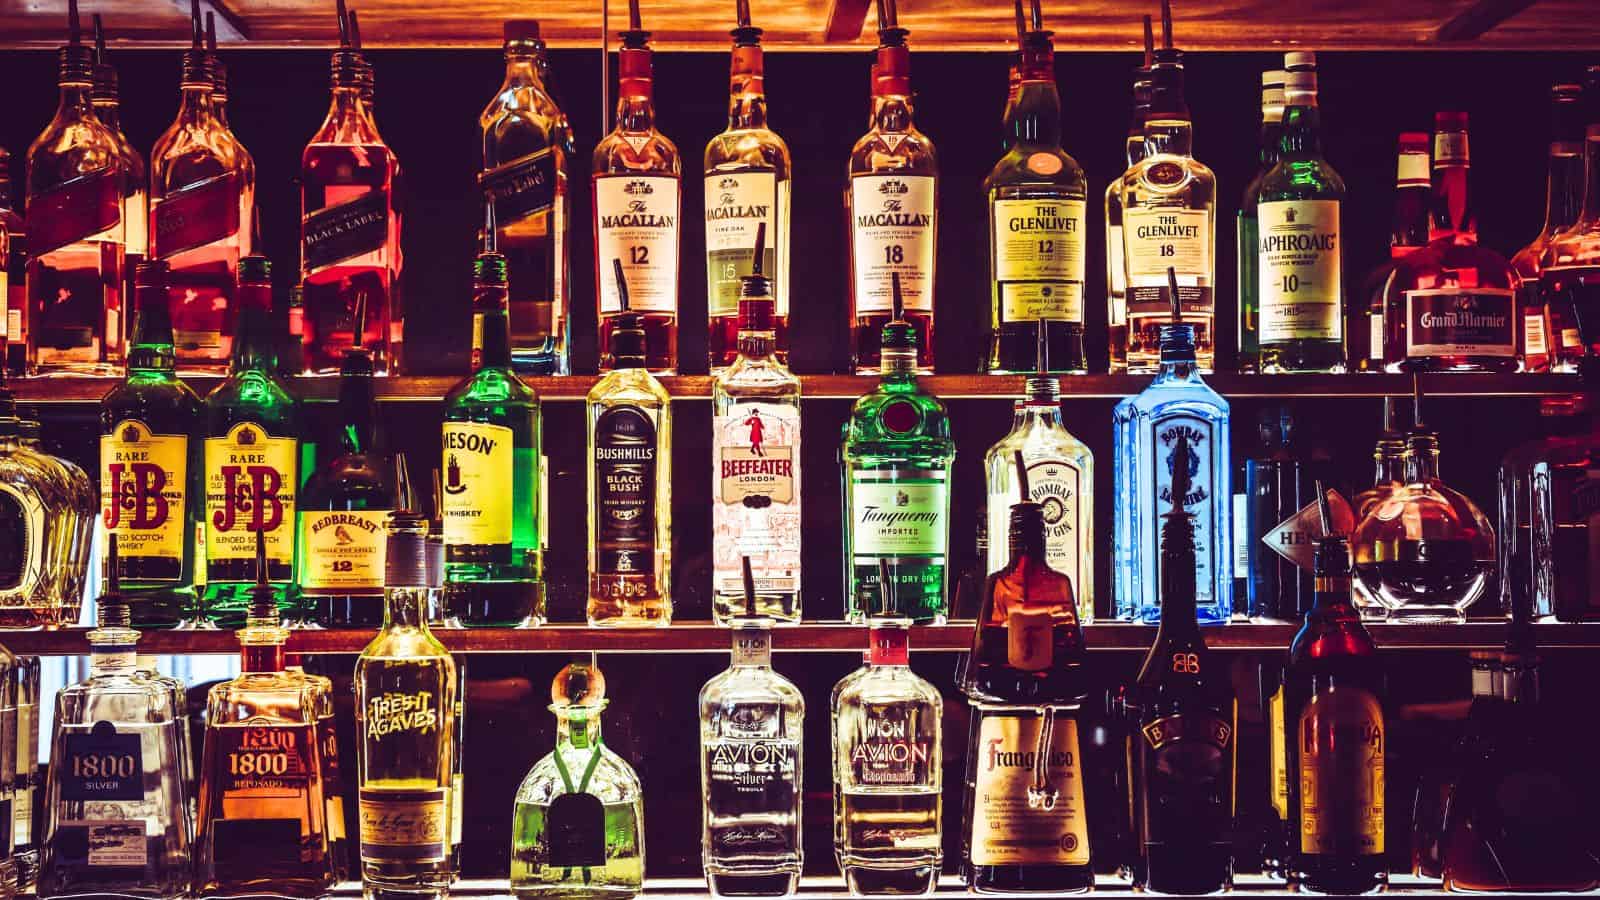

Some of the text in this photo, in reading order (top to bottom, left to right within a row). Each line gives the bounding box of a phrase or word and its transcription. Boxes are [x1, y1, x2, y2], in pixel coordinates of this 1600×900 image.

[1035, 206, 1057, 217] THE
[602, 215, 675, 228] MACALLAN
[858, 213, 930, 227] MACALLAN
[1010, 217, 1078, 233] GLENLIVET
[1158, 216, 1178, 225] THE
[1137, 225, 1198, 239] GLENLIVET
[884, 244, 904, 264] 18
[1039, 240, 1055, 254] 12
[1160, 244, 1175, 257] 18
[630, 246, 649, 265] 12
[721, 263, 737, 281] 15
[1282, 274, 1298, 293] 10
[116, 452, 149, 461] RARE
[229, 454, 266, 464] RARE
[596, 447, 654, 461] BUSHMILLS
[721, 459, 793, 480] BEEFEATER
[607, 474, 643, 484] BLACK
[609, 483, 640, 492] BUSH
[1031, 483, 1073, 501] BOMBAY
[861, 505, 938, 527] Tanqueray
[312, 513, 378, 535] REDBREAST
[1053, 521, 1072, 538] GIN
[878, 528, 919, 536] IMPORTED
[215, 536, 280, 544] BLENDED SCTCH
[231, 544, 257, 553] WHISK
[332, 560, 353, 572] 12
[902, 575, 919, 584] DRY
[367, 708, 437, 742] AGAVES
[73, 754, 136, 778] 1800
[229, 752, 288, 776] 1800
[85, 781, 120, 791] SILVER
[734, 772, 766, 786] Silver
